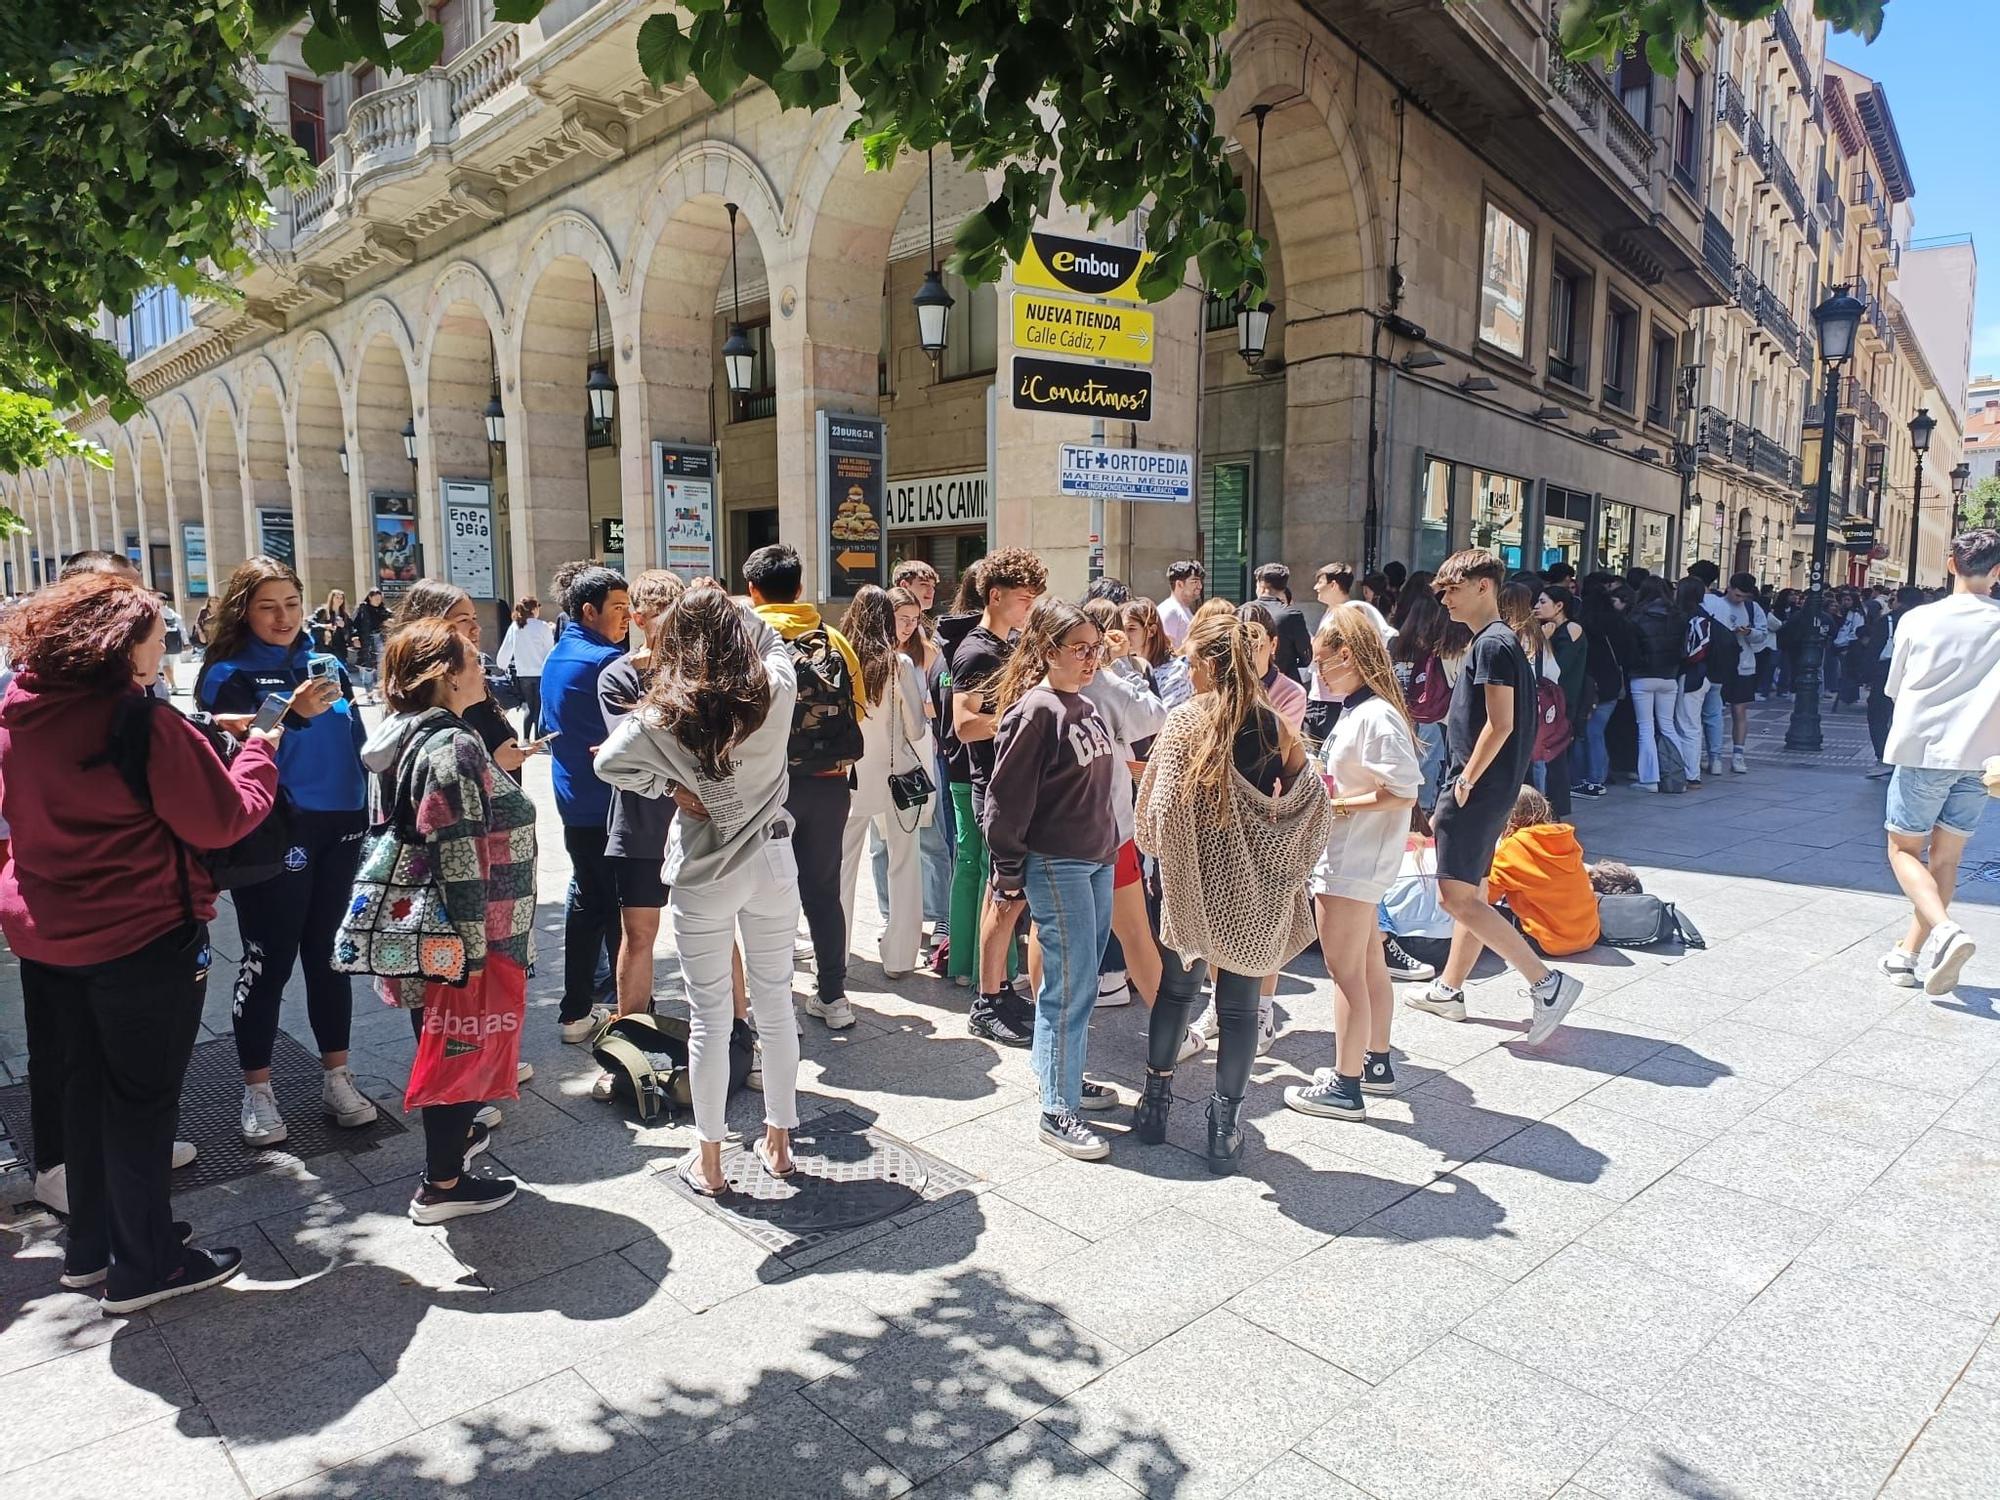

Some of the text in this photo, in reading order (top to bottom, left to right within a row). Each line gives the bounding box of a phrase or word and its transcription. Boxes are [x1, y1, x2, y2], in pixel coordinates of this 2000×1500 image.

[1052, 250, 1119, 278] embou
[1026, 303, 1121, 331] NUEVA TIENDA
[1026, 326, 1106, 351] Calle Cádiz, 7
[1020, 375, 1147, 410] ¿Conectamos?
[1064, 448, 1188, 475] TEF ORTOPEDIA
[1063, 472, 1132, 483] MATERIAL
[1088, 482, 1136, 493] INDEPENDENCIA
[898, 487, 914, 524] DE
[919, 483, 943, 521] LAS
[947, 480, 988, 520] CAMI
[450, 508, 486, 523] Ener
[456, 522, 488, 537] geia
